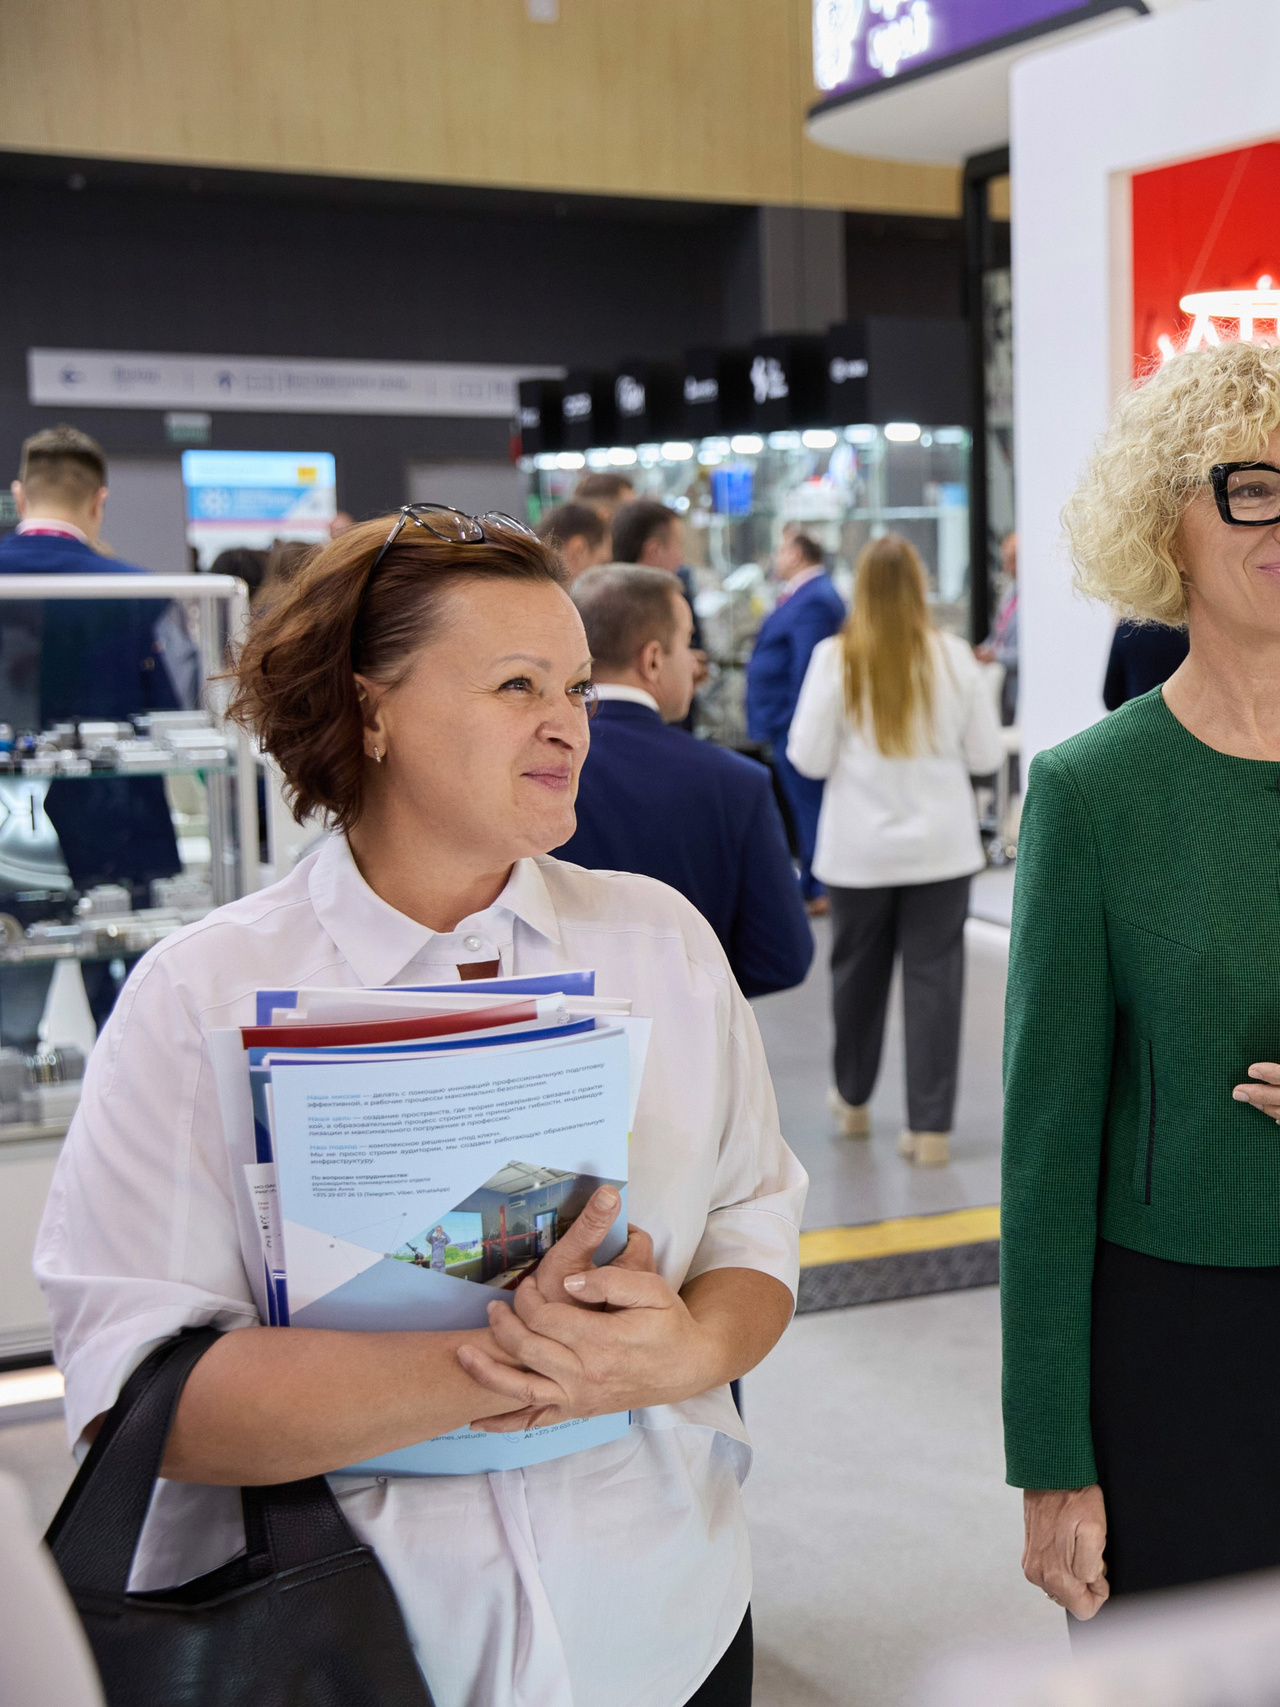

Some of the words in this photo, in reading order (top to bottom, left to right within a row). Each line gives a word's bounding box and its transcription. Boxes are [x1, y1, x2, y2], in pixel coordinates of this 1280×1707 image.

[307, 1100, 363, 1108] эффективной,
[370, 1098, 403, 1107] рабочие
[404, 1095, 444, 1104] процессы
[444, 1088, 495, 1100] максимально
[496, 1080, 549, 1096] безопасными.
[372, 1091, 400, 1099] делать
[408, 1087, 446, 1096] помощью
[447, 1081, 490, 1092] инноваций
[492, 1069, 564, 1087] профессиональную
[565, 1062, 605, 1075] подготовку
[308, 1122, 323, 1130] кой,
[333, 1120, 403, 1129] образовательный
[404, 1117, 437, 1126] процесс
[438, 1112, 473, 1123] строится
[485, 1105, 527, 1117] принципах
[528, 1099, 562, 1109] гибкости,
[563, 1091, 605, 1103] индивидуа-
[362, 1113, 400, 1121] создание
[401, 1108, 452, 1119] пространств,
[468, 1103, 495, 1113] теория
[495, 1096, 541, 1109] неразрывно
[542, 1090, 571, 1100] связана
[577, 1084, 605, 1094] практи-
[351, 1126, 412, 1135] максимального
[412, 1122, 460, 1132] погружения
[466, 1115, 511, 1127] профессию.
[368, 1149, 398, 1157] строим
[400, 1146, 444, 1155] аудитории,
[460, 1140, 492, 1149] создаем
[494, 1131, 541, 1144] работающую
[543, 1118, 606, 1135] образовательную
[368, 1141, 420, 1149] комплексное
[421, 1137, 457, 1146] решение
